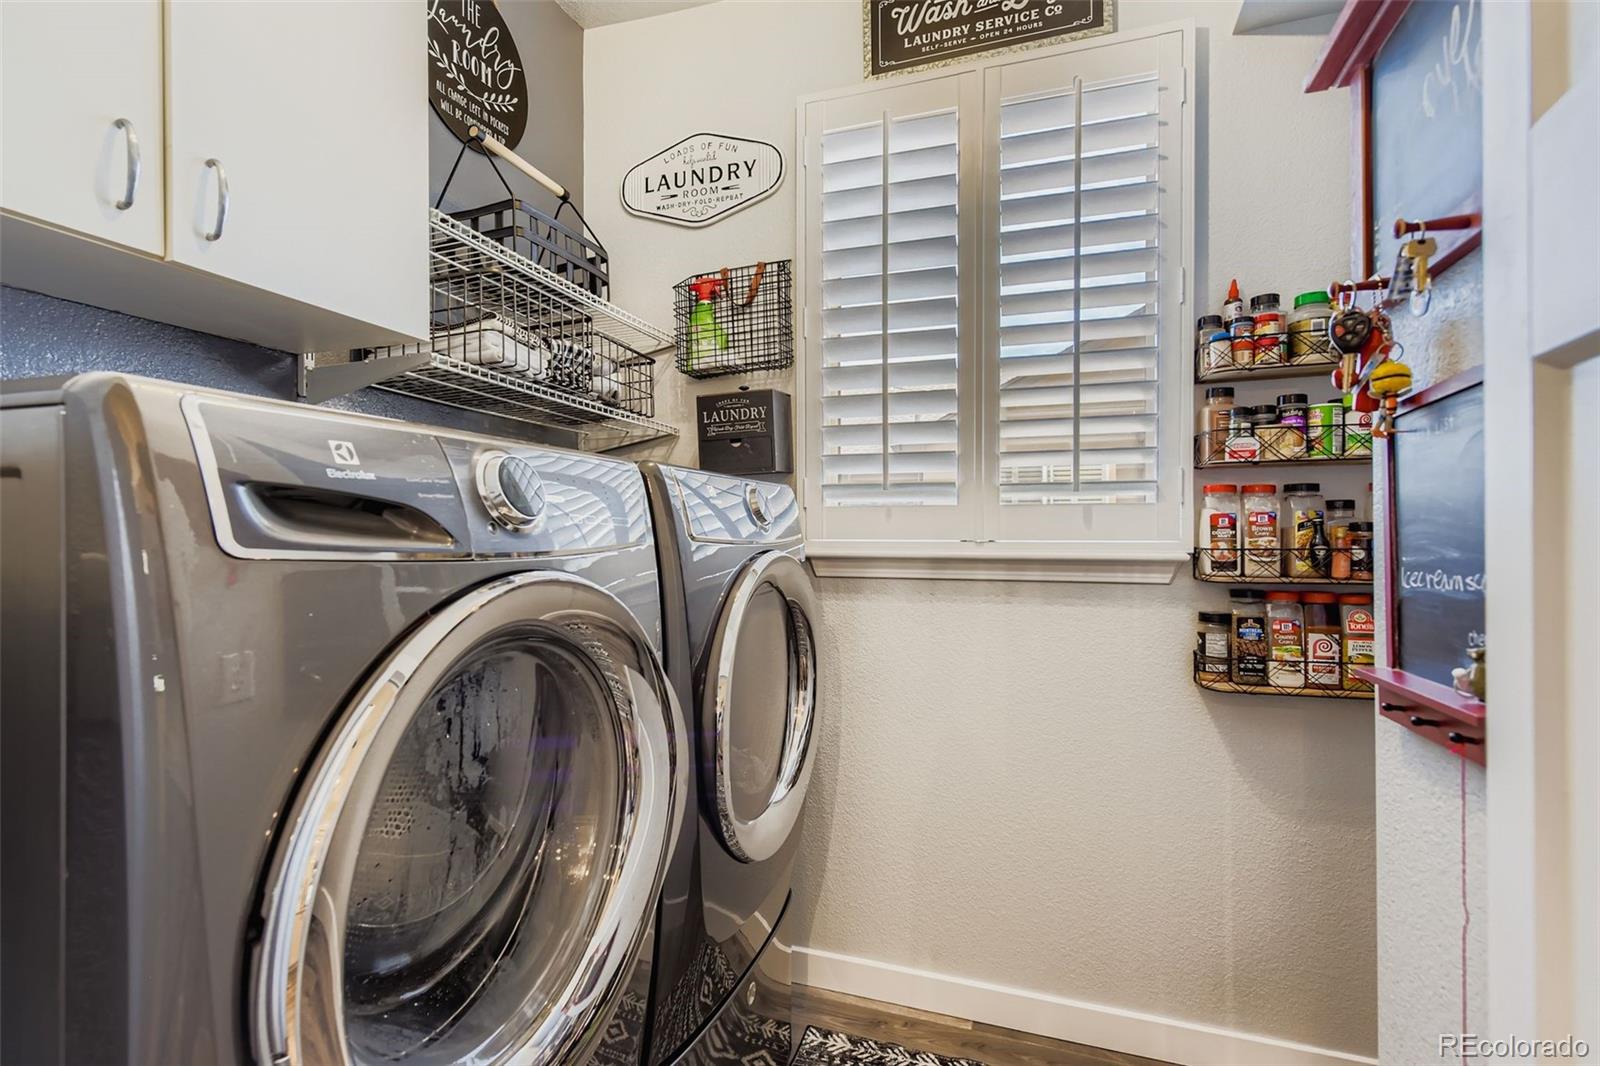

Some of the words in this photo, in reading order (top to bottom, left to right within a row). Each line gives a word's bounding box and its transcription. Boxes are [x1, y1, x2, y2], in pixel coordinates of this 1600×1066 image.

[891, 0, 973, 36] Wash
[904, 24, 971, 48] LAUNDRY
[975, 8, 1040, 32] SERVICE
[921, 37, 967, 53] SELF-SERVE
[979, 30, 1001, 40] OPEN
[1016, 21, 1043, 32] HOURS
[451, 39, 492, 88] ROOM
[436, 80, 446, 96] ALL
[447, 87, 468, 109] CHANGE
[469, 101, 481, 118] LEFT
[663, 145, 695, 165] LOADS
[700, 141, 712, 151] OF
[719, 142, 738, 153] FUN
[645, 159, 757, 194] LAUNDRY
[682, 186, 719, 199] ROOM
[702, 405, 767, 424] LAUNDRY
